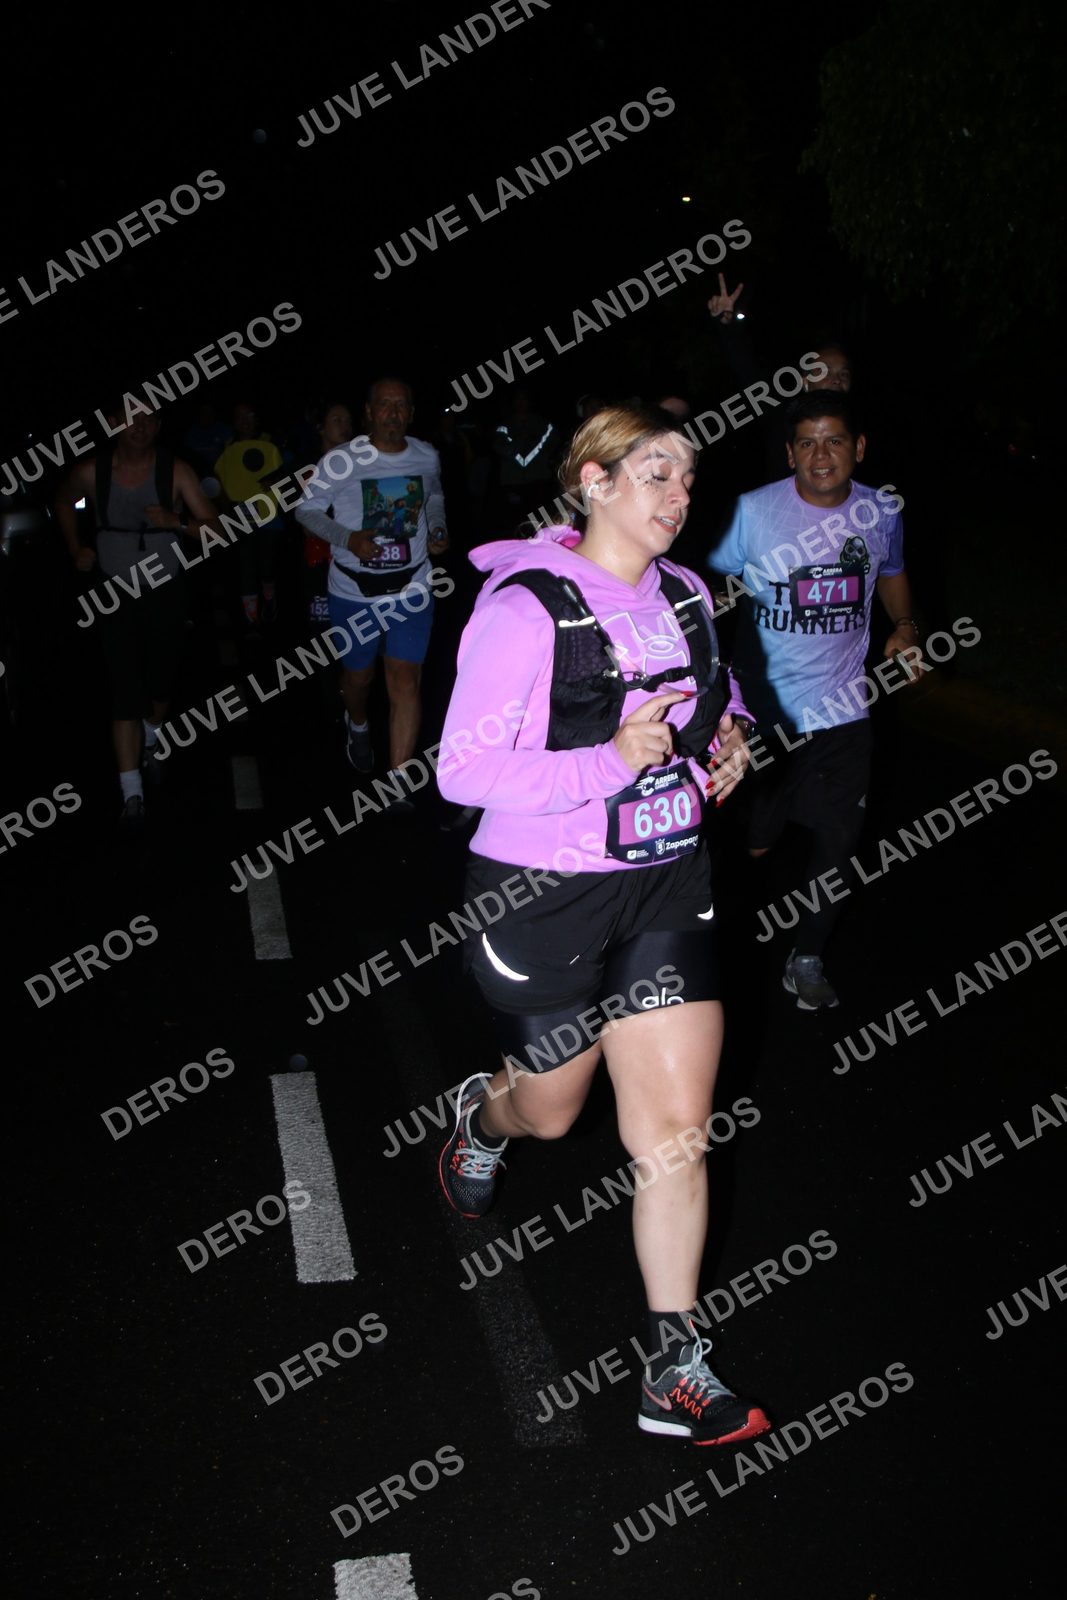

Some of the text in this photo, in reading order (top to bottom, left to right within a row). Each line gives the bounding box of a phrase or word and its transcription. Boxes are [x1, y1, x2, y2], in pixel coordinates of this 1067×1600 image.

[380, 546, 401, 561] 38
[807, 579, 847, 603] 471
[755, 605, 865, 635] RUNNERS
[634, 791, 691, 838] 630
